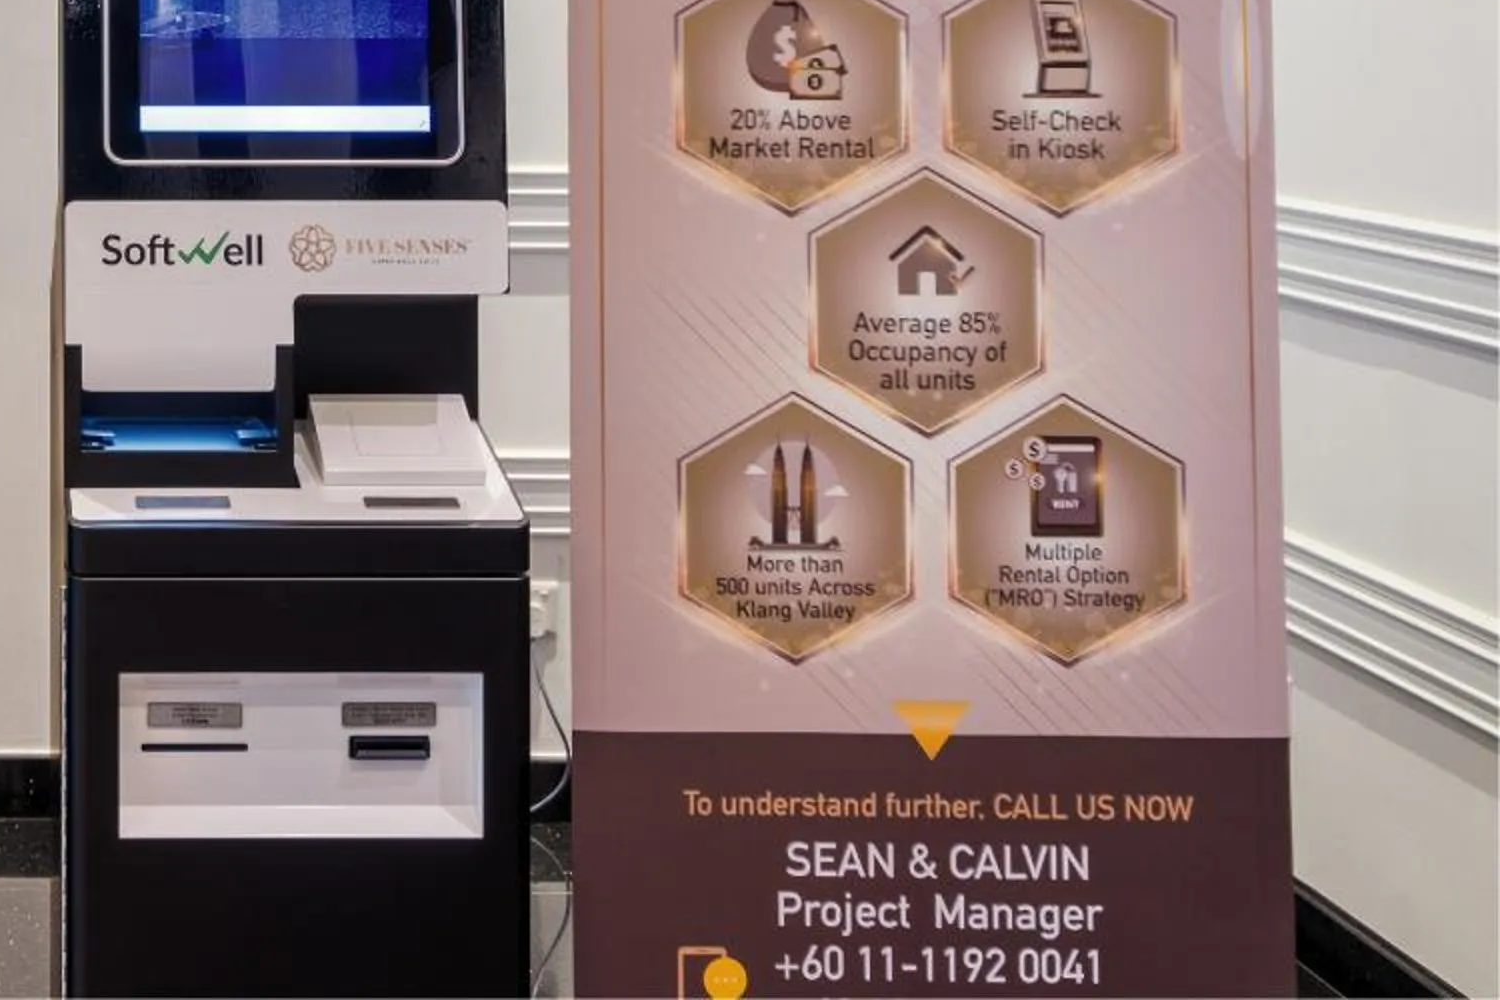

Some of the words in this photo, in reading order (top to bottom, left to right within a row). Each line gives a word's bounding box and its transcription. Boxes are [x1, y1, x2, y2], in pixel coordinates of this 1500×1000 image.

[730, 109, 772, 131] 20%
[779, 110, 851, 133] Above
[992, 111, 1121, 133] Self-Check
[709, 138, 790, 160] Market
[799, 138, 875, 160] Rental
[1009, 138, 1032, 160] in
[1039, 138, 1105, 161] Kiosk
[853, 313, 952, 339] Average
[958, 313, 1001, 334] 85%
[849, 341, 979, 366] Occupancy
[986, 342, 1008, 363] of
[879, 371, 909, 390] all
[917, 371, 976, 391] units
[746, 556, 795, 573] More
[801, 556, 844, 573] than
[1026, 543, 1102, 566] Multiple
[716, 578, 749, 596] 500
[755, 578, 803, 596] units
[809, 578, 876, 596] Across
[999, 566, 1061, 585] Rental
[1067, 566, 1129, 589] Option
[737, 602, 792, 622] Klang
[799, 602, 856, 622] Valley
[1063, 589, 1146, 612] Strategy
[683, 790, 713, 816] To
[720, 792, 877, 818] understand
[994, 794, 1067, 820] CALL
[1076, 795, 1115, 820] US
[1124, 796, 1194, 821] NOW
[786, 843, 895, 878] SEAN
[908, 844, 937, 879] &
[949, 845, 1089, 880] CALVIN
[776, 891, 911, 935] Project
[935, 895, 1103, 939] Manager
[775, 946, 844, 982] +60
[858, 947, 1006, 984] 11-1192
[1018, 949, 1100, 984] 0041
